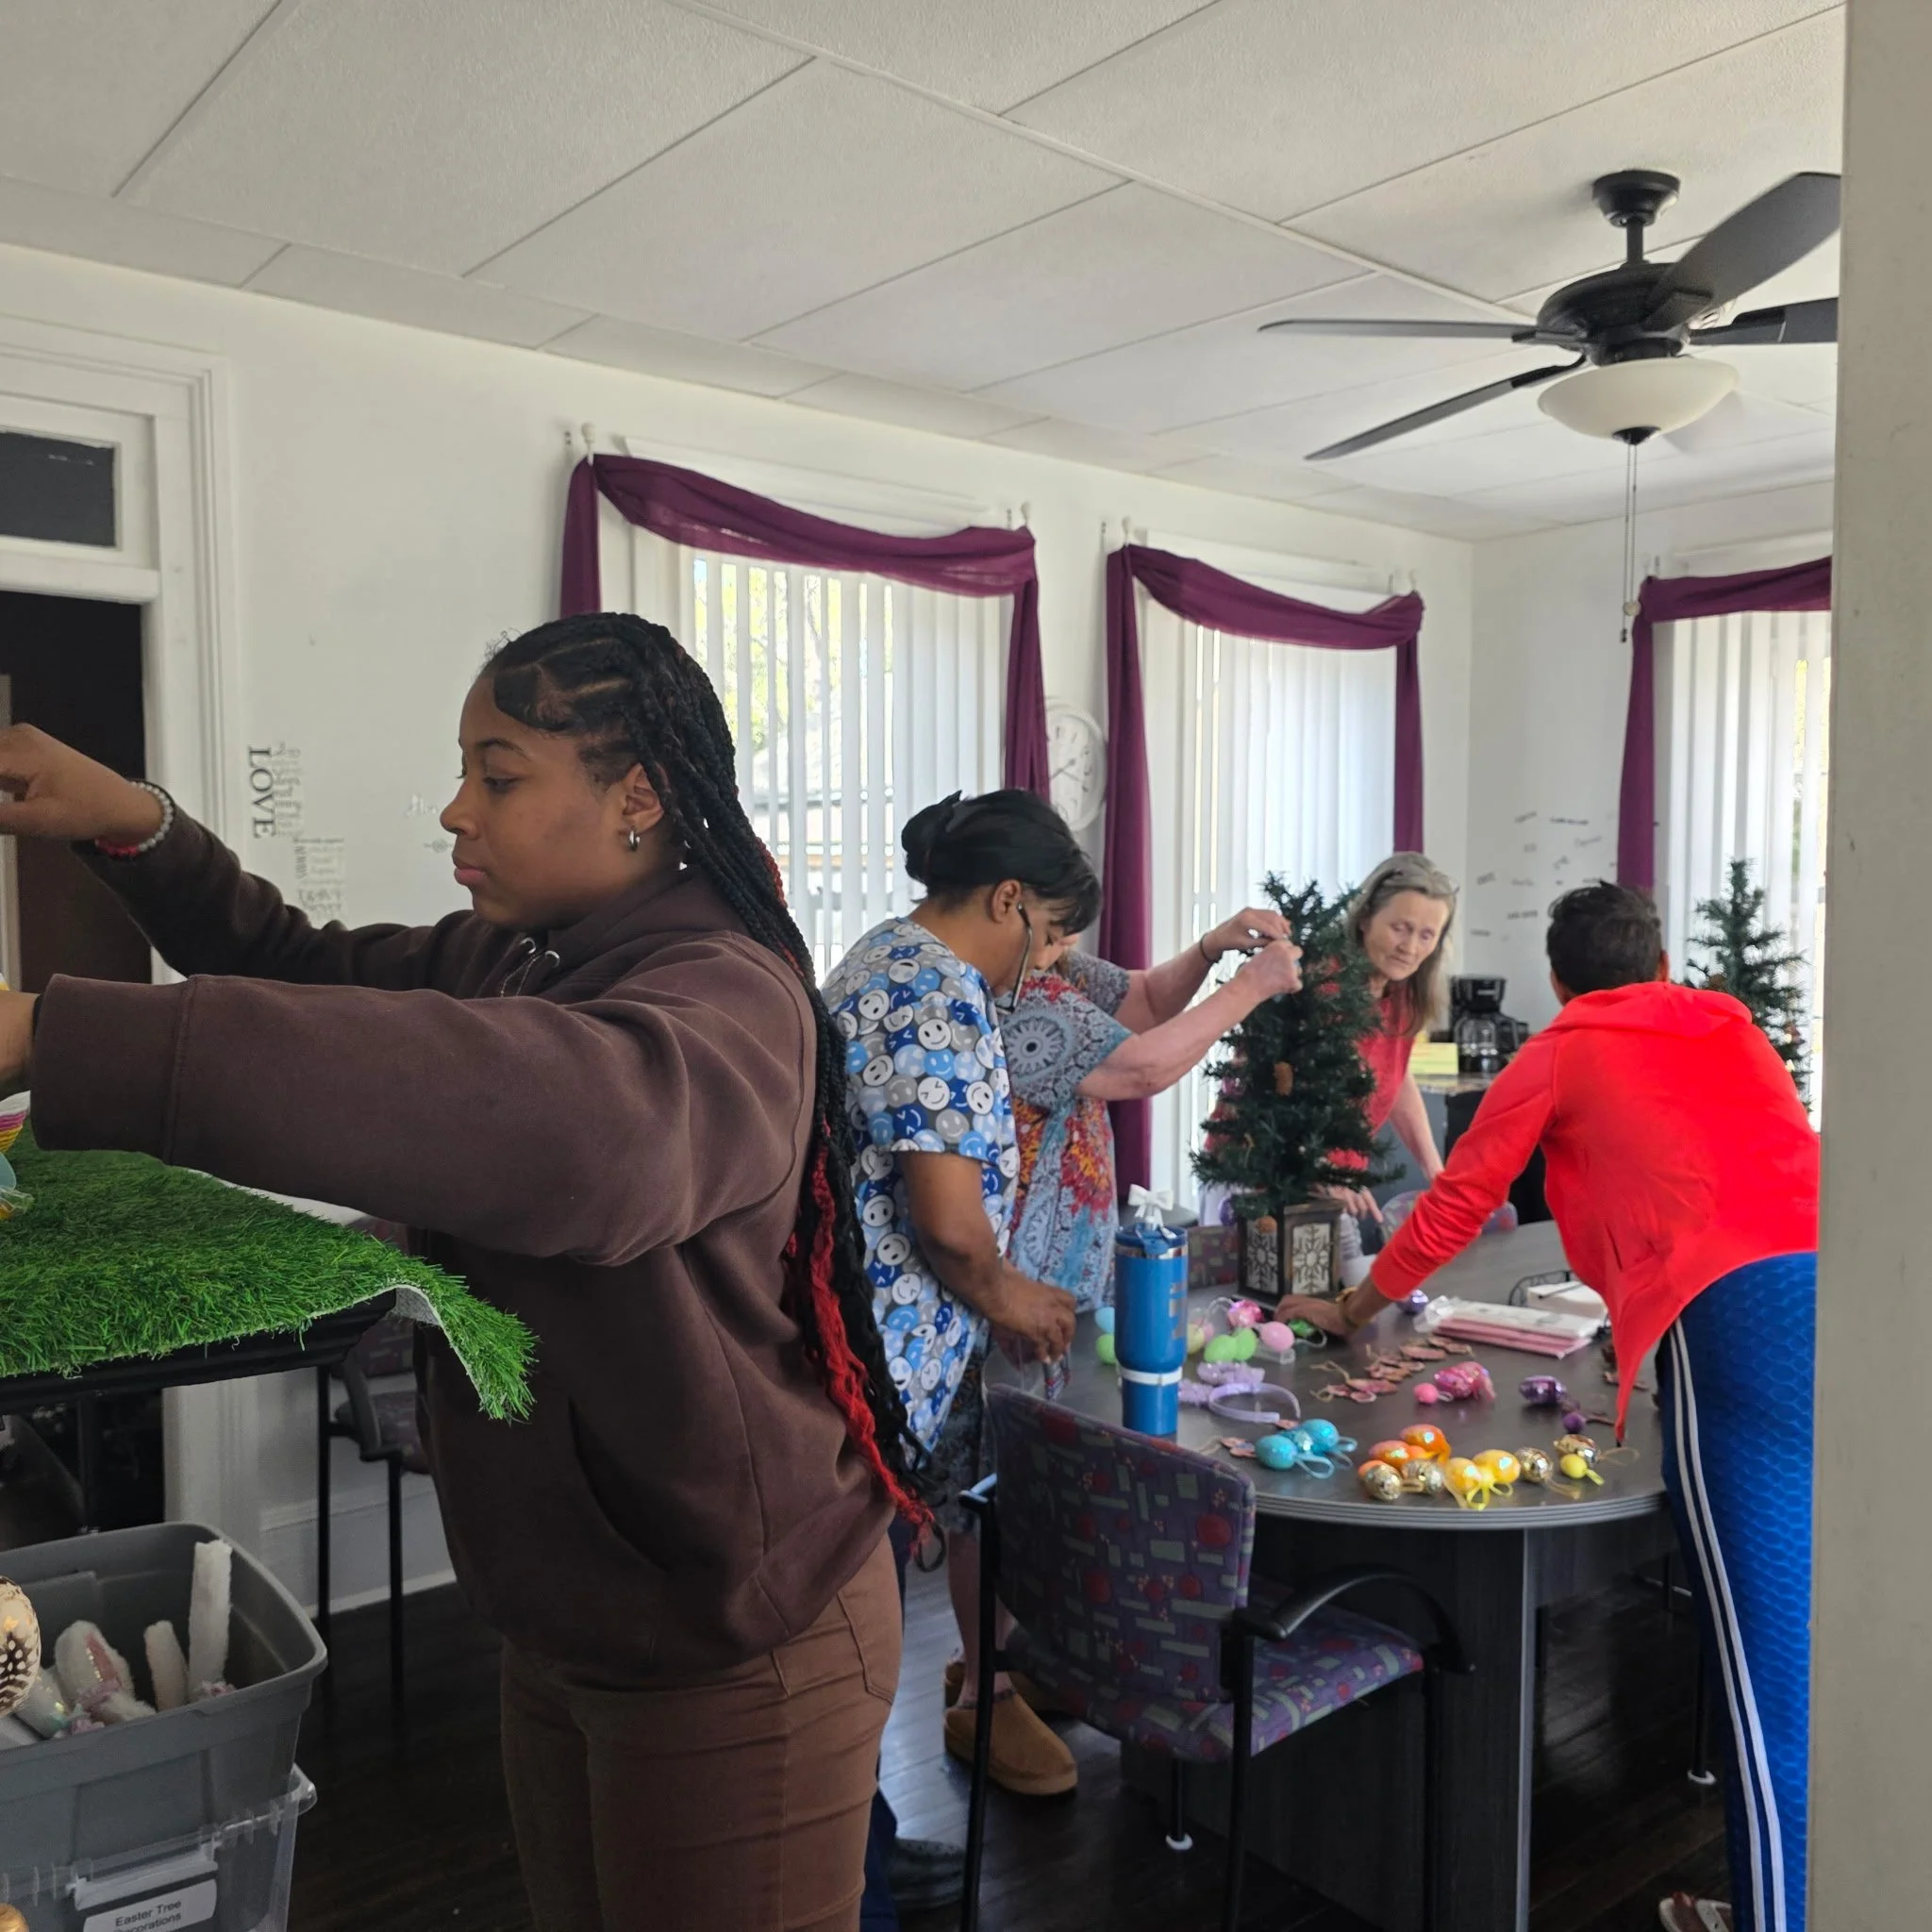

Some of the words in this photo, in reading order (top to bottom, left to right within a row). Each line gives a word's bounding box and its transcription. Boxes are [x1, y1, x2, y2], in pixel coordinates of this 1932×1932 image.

[248, 745, 276, 838] LOVE
[115, 1909, 153, 1926] Easter
[157, 1900, 182, 1914] Tree
